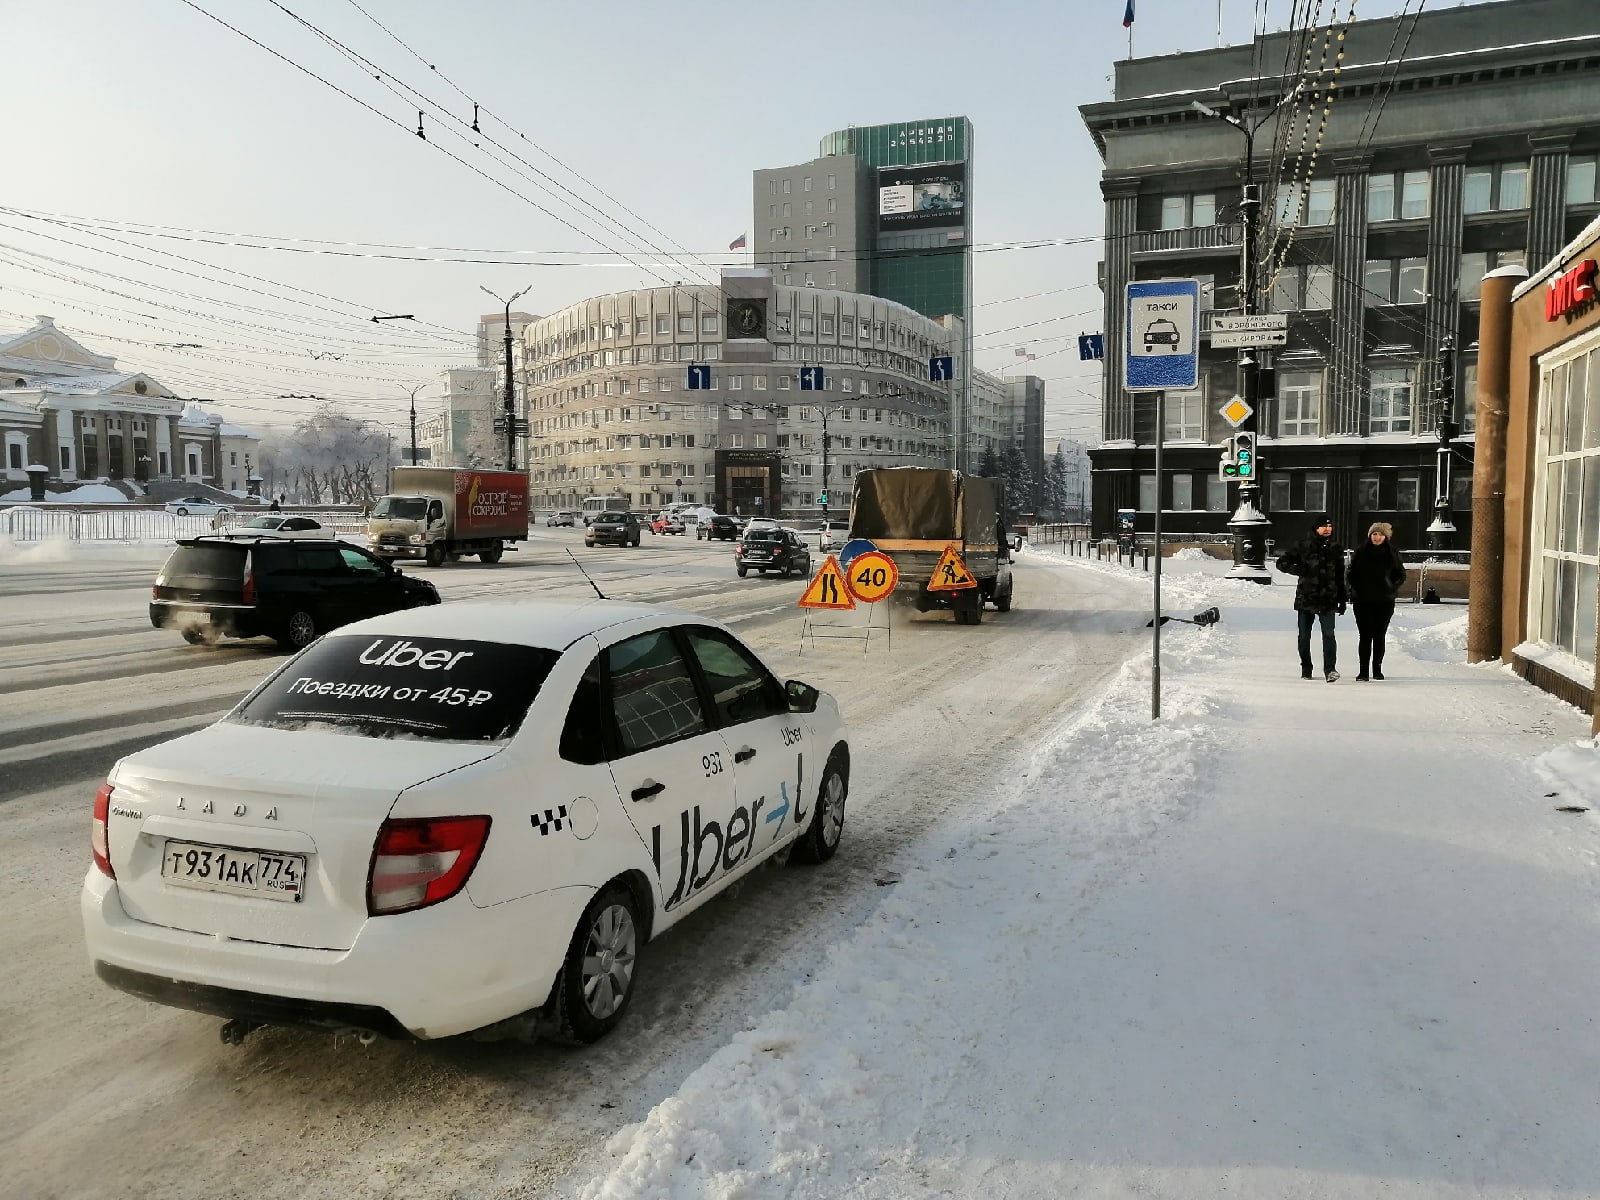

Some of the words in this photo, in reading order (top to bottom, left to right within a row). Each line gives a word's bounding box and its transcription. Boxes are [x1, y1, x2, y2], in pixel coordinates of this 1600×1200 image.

[1146, 302, 1178, 312] такси
[856, 567, 887, 587] 40
[358, 639, 474, 671] Uber
[286, 677, 391, 700] Поездки
[392, 687, 428, 702] от
[780, 726, 803, 747] Uber
[702, 751, 724, 778] 931
[176, 797, 279, 821] LADA
[652, 796, 765, 913] Uber
[261, 856, 296, 882] 774
[266, 879, 285, 890] RUS
